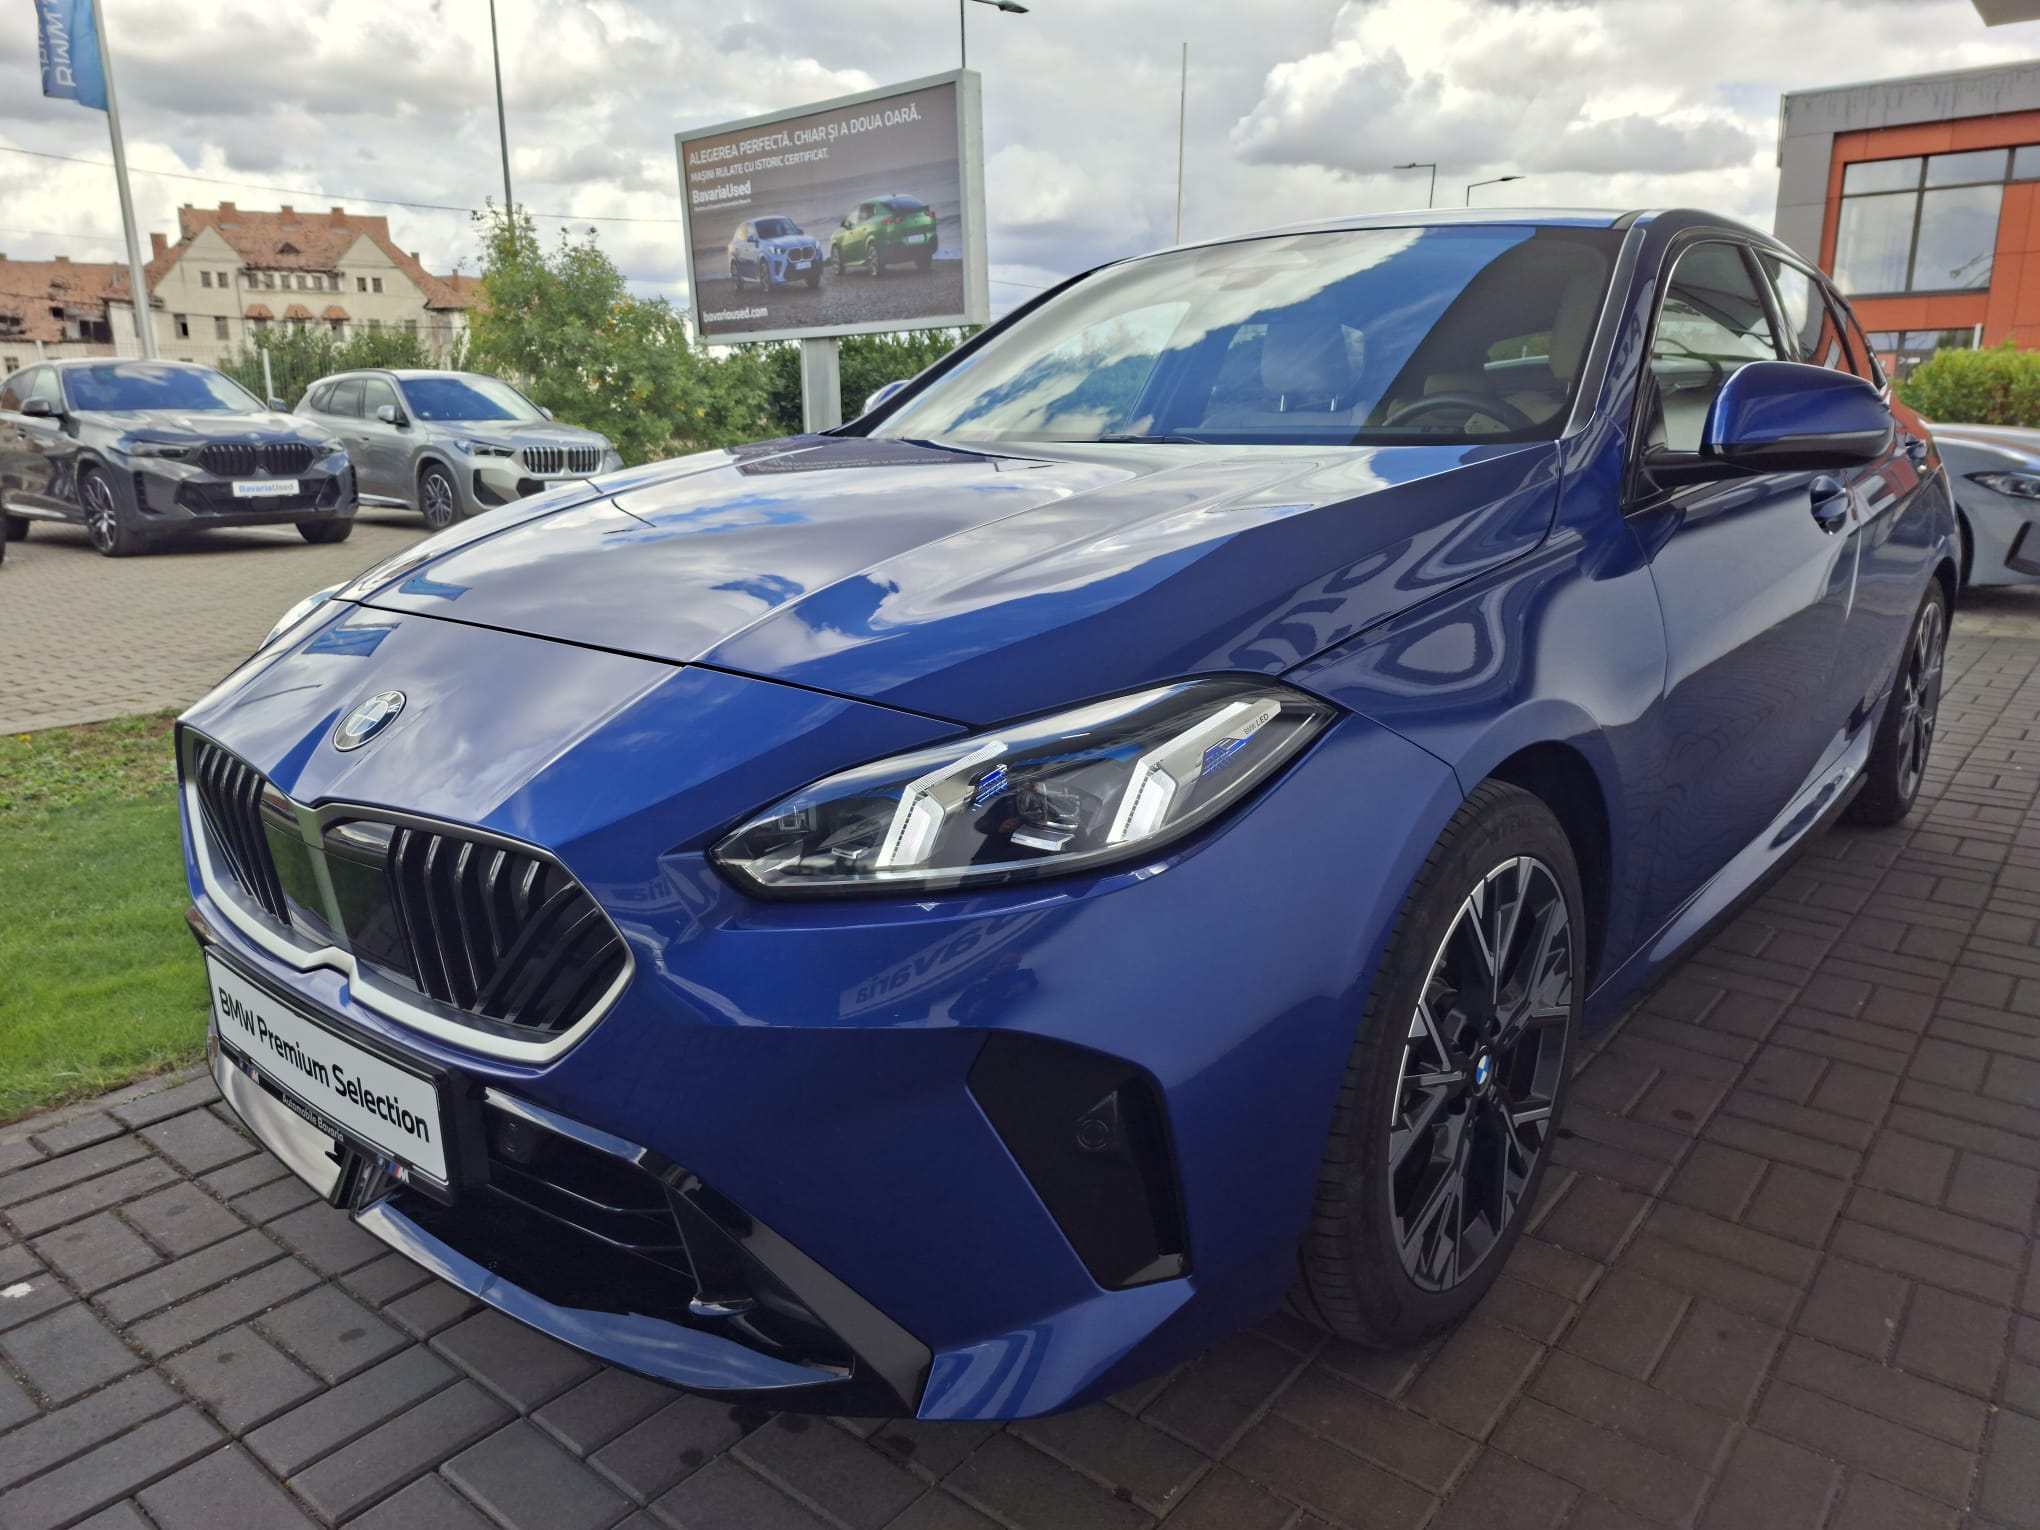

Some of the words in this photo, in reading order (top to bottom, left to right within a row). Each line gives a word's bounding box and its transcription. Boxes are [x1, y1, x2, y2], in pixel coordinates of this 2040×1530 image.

[689, 144, 739, 165] ALEGEREA
[740, 130, 793, 155] PERFECTĂ.
[794, 126, 826, 145] CHIAR
[828, 123, 838, 143] ȘI
[840, 121, 849, 136] A
[850, 113, 883, 133] DOUA
[884, 102, 922, 126] OARĂ.
[716, 163, 743, 177] RULATE
[744, 161, 754, 173] CU
[755, 156, 783, 170] ISTORIC
[784, 147, 830, 165] CERTIFICAT.
[692, 180, 752, 204] BavariaUsed
[703, 306, 768, 322] bavariaused.com
[1255, 713, 1269, 727] LED
[218, 986, 255, 1036] BMW
[257, 1014, 330, 1088] Premium
[332, 1063, 430, 1143] Selection
[282, 1093, 317, 1125] Automobile
[317, 1116, 344, 1142] Bavaria
[398, 1168, 410, 1184] M
